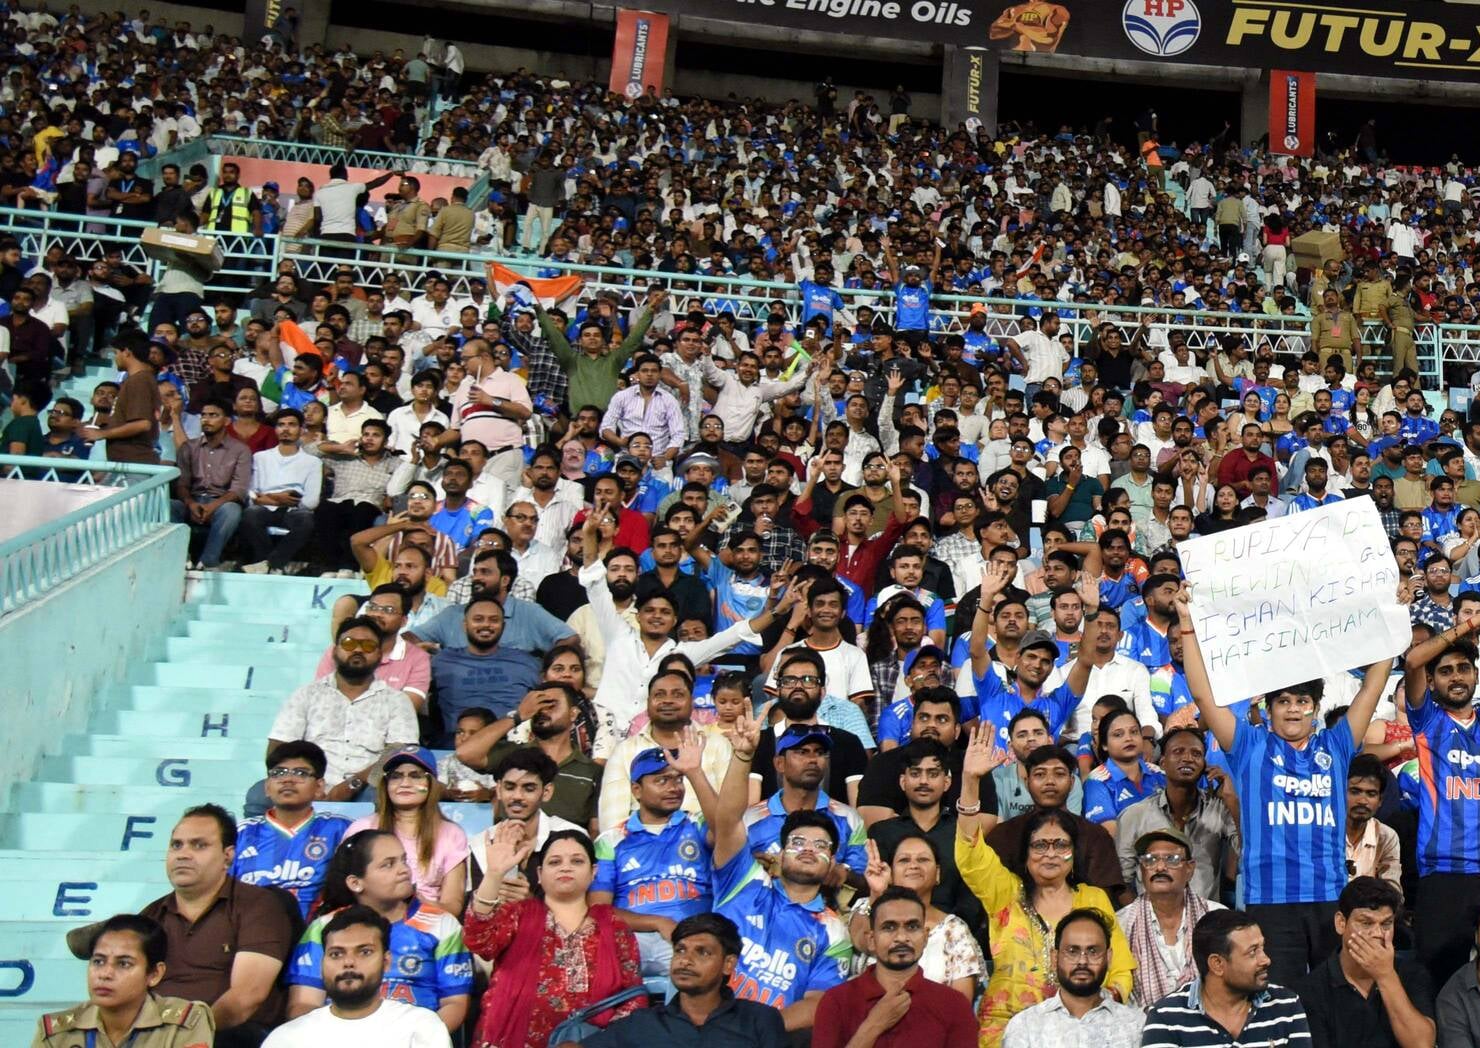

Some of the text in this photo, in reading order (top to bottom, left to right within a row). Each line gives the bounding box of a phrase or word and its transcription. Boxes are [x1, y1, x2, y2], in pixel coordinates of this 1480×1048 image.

[911, 1, 972, 26] Oils
[1143, 0, 1185, 17] HP
[632, 24, 648, 80] LUBRICANTS
[969, 55, 982, 113] FUTUR-X
[1288, 80, 1298, 133] LUBRICANTS
[1180, 549, 1202, 575] 2
[1213, 515, 1330, 565] RUPIYA
[311, 585, 334, 609] K
[1190, 559, 1328, 608] CHEWIN
[1199, 568, 1398, 643] ISHAN KISHAN
[201, 713, 229, 737] H
[156, 759, 191, 787] G
[1273, 774, 1332, 795] apollo
[1268, 801, 1336, 827] INDIA
[120, 816, 156, 851] F
[53, 882, 98, 916] E
[628, 879, 701, 907] INDIA
